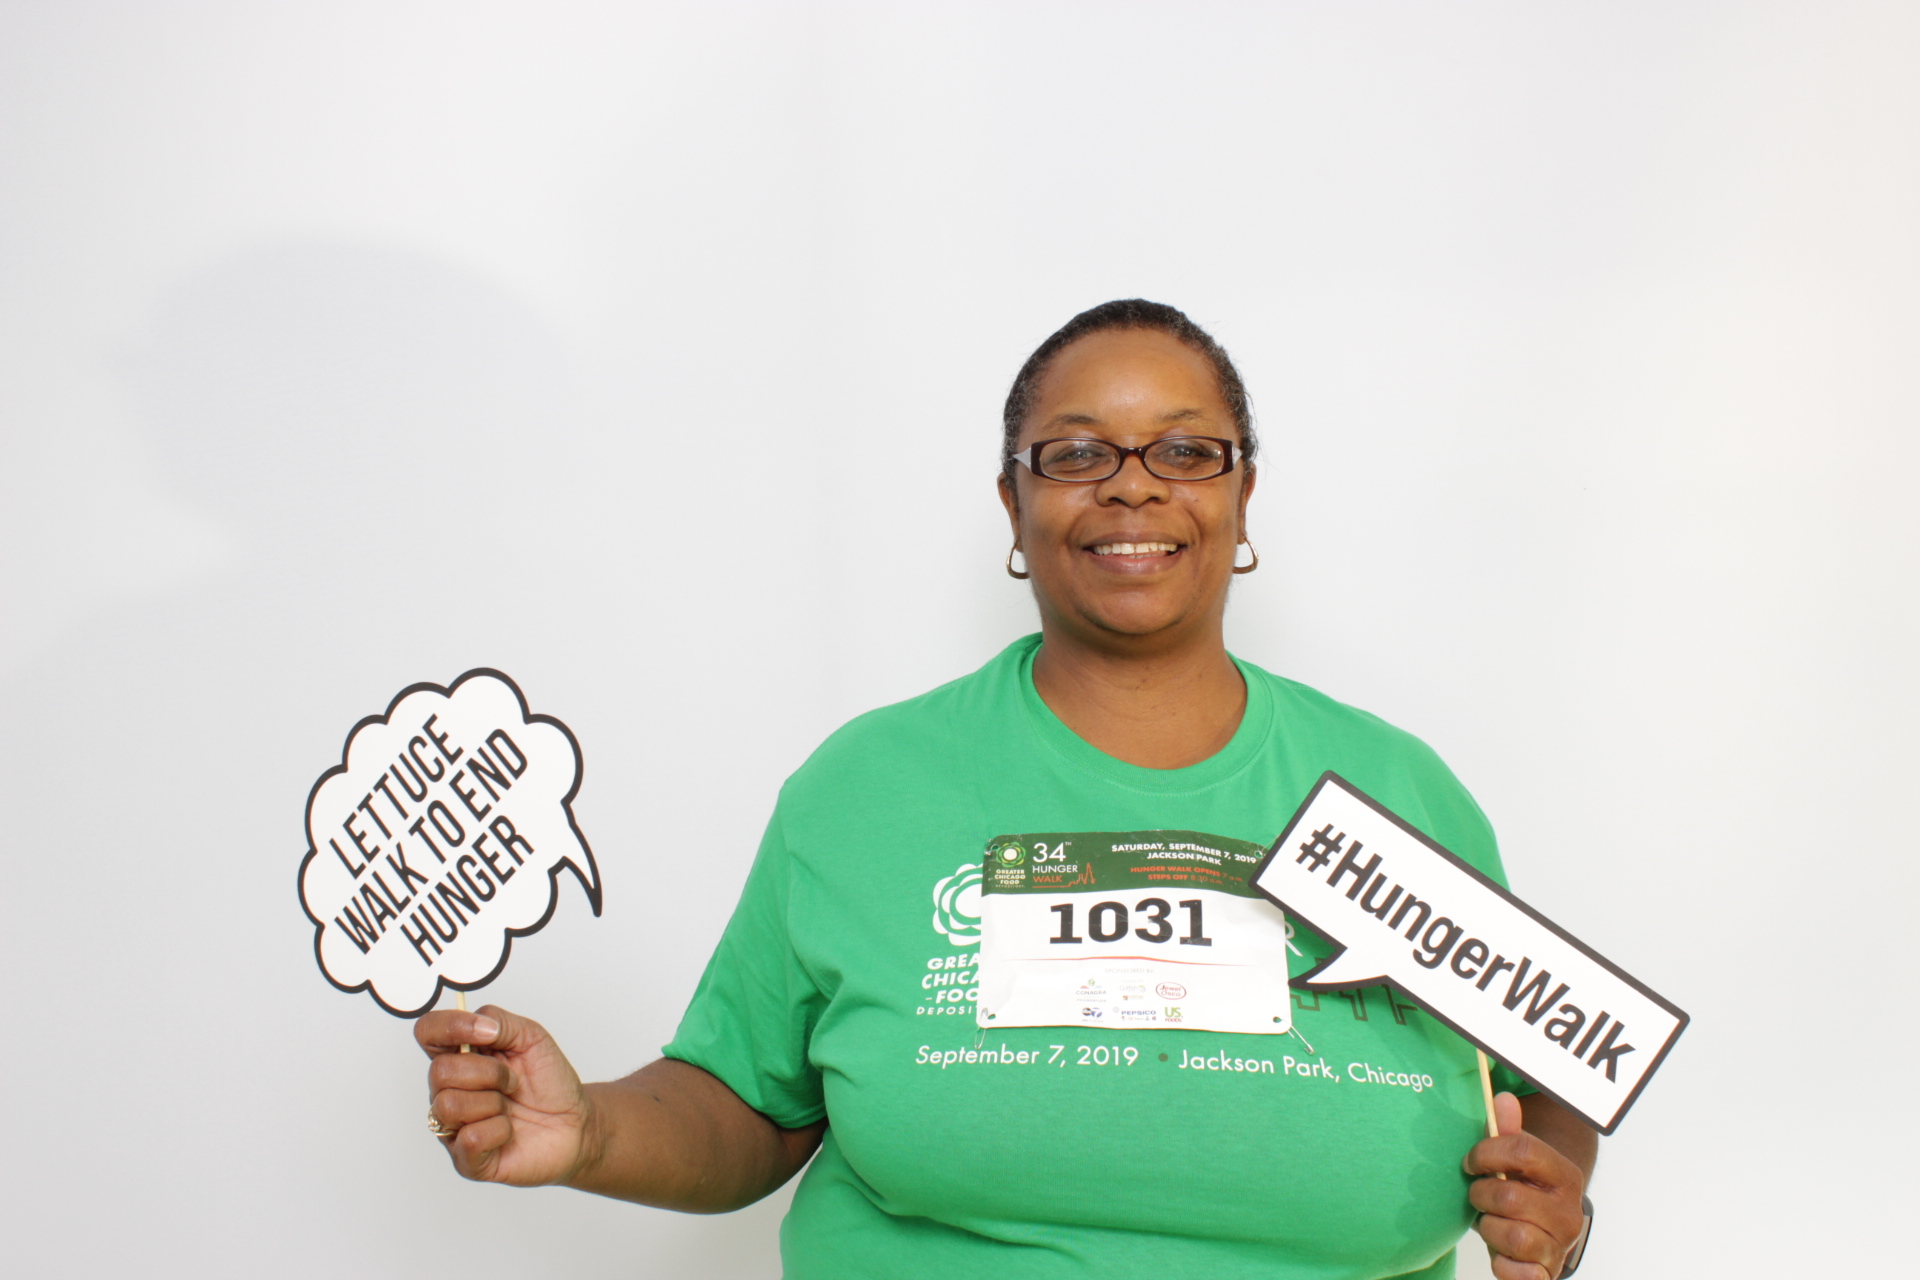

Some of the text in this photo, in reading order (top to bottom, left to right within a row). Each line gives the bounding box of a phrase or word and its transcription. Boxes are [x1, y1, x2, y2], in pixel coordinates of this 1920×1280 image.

[329, 714, 464, 880] LETTUCE
[334, 729, 527, 955] WALK TO END
[1112, 843, 1256, 864] SATURDAY, SEPTEMBER 7, 2019
[1196, 854, 1222, 866] PARK
[1032, 865, 1078, 873] HUNGER
[1194, 868, 1221, 876] OPENS
[400, 815, 534, 967] HUNGER
[1050, 898, 1212, 946] 1031
[927, 953, 980, 970] GREA
[1296, 824, 1636, 1083] #HungerWalk
[922, 971, 979, 990] CHICA
[917, 1006, 976, 1015] DEPOSI
[1165, 1007, 1182, 1017] US
[915, 1044, 1433, 1092] September 7, 2019 Jackson Park, Chicago
